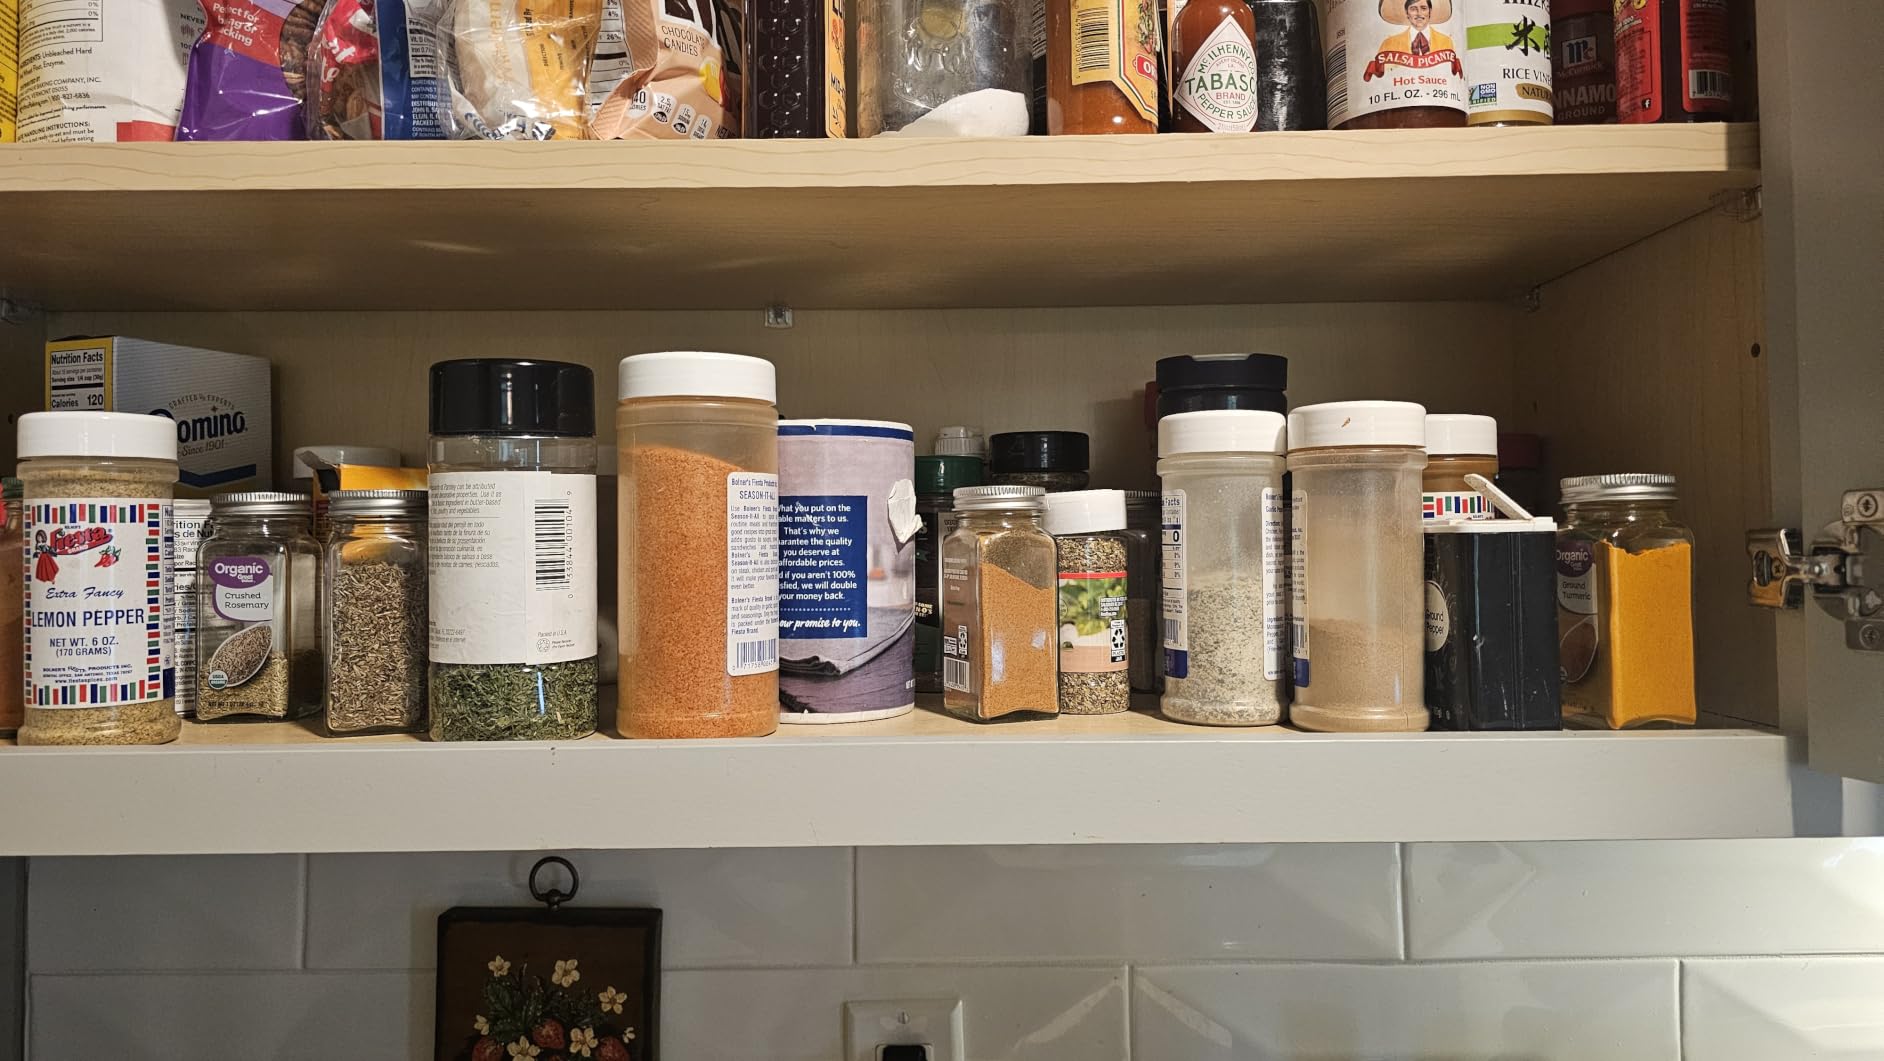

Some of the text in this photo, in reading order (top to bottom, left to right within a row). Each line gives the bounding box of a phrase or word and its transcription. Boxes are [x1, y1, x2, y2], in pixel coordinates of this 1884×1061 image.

[244, 10, 260, 22] for
[664, 37, 699, 56] CANDIES
[43, 48, 74, 58] Unbleached
[1377, 52, 1456, 67] SALSA PICANTE
[1503, 68, 1530, 79] RICE
[54, 78, 86, 86] COMPANY,
[1185, 72, 1256, 96] TABASC
[1393, 75, 1447, 87] Hot Sauce
[1216, 92, 1246, 100] BRAND
[1369, 89, 1461, 105] 10 FL. OZ. 296 mL
[1552, 83, 1616, 110] NNAMO
[1198, 93, 1234, 120] PEPPER
[1558, 106, 1606, 120] GROUND
[46, 122, 91, 132] INSTRUCTIONS:
[51, 351, 103, 365] Nutrition Facts
[51, 376, 66, 384] Serving
[51, 394, 103, 409] Calories 120
[168, 394, 234, 410] CRAFTED EXPERTS
[182, 439, 224, 457] Since 1901
[732, 478, 751, 486] Bolner's
[1166, 497, 1180, 506] Facts
[795, 505, 809, 514] you
[811, 505, 824, 514] put
[838, 504, 851, 512] the
[778, 514, 793, 522] able
[795, 515, 825, 523] matters
[183, 530, 192, 538] de
[784, 527, 807, 535] That's
[809, 527, 826, 536] why
[1173, 530, 1180, 542] 0
[825, 537, 852, 546] quality
[783, 549, 796, 557] you
[798, 548, 830, 556] deserve
[1557, 550, 1589, 565] Organic
[779, 558, 845, 567] affordable prices.
[214, 562, 264, 578] Organic
[785, 571, 856, 580] if you aren't 100%
[814, 581, 829, 590] will
[830, 581, 857, 590] double
[1562, 582, 1586, 590] Ground
[46, 587, 125, 600] Extra Fancy
[796, 594, 823, 602] money
[824, 592, 845, 600] back.
[1562, 591, 1592, 600] Turmeric
[225, 602, 269, 610] Rosemary
[32, 608, 144, 628] LEMON PEPPER
[779, 617, 861, 632] our promise to you.
[49, 636, 119, 648] NET WT. 6 OZ.
[56, 646, 112, 658] (170 GRAMS)
[55, 676, 118, 684] www.fiestaspices.com
